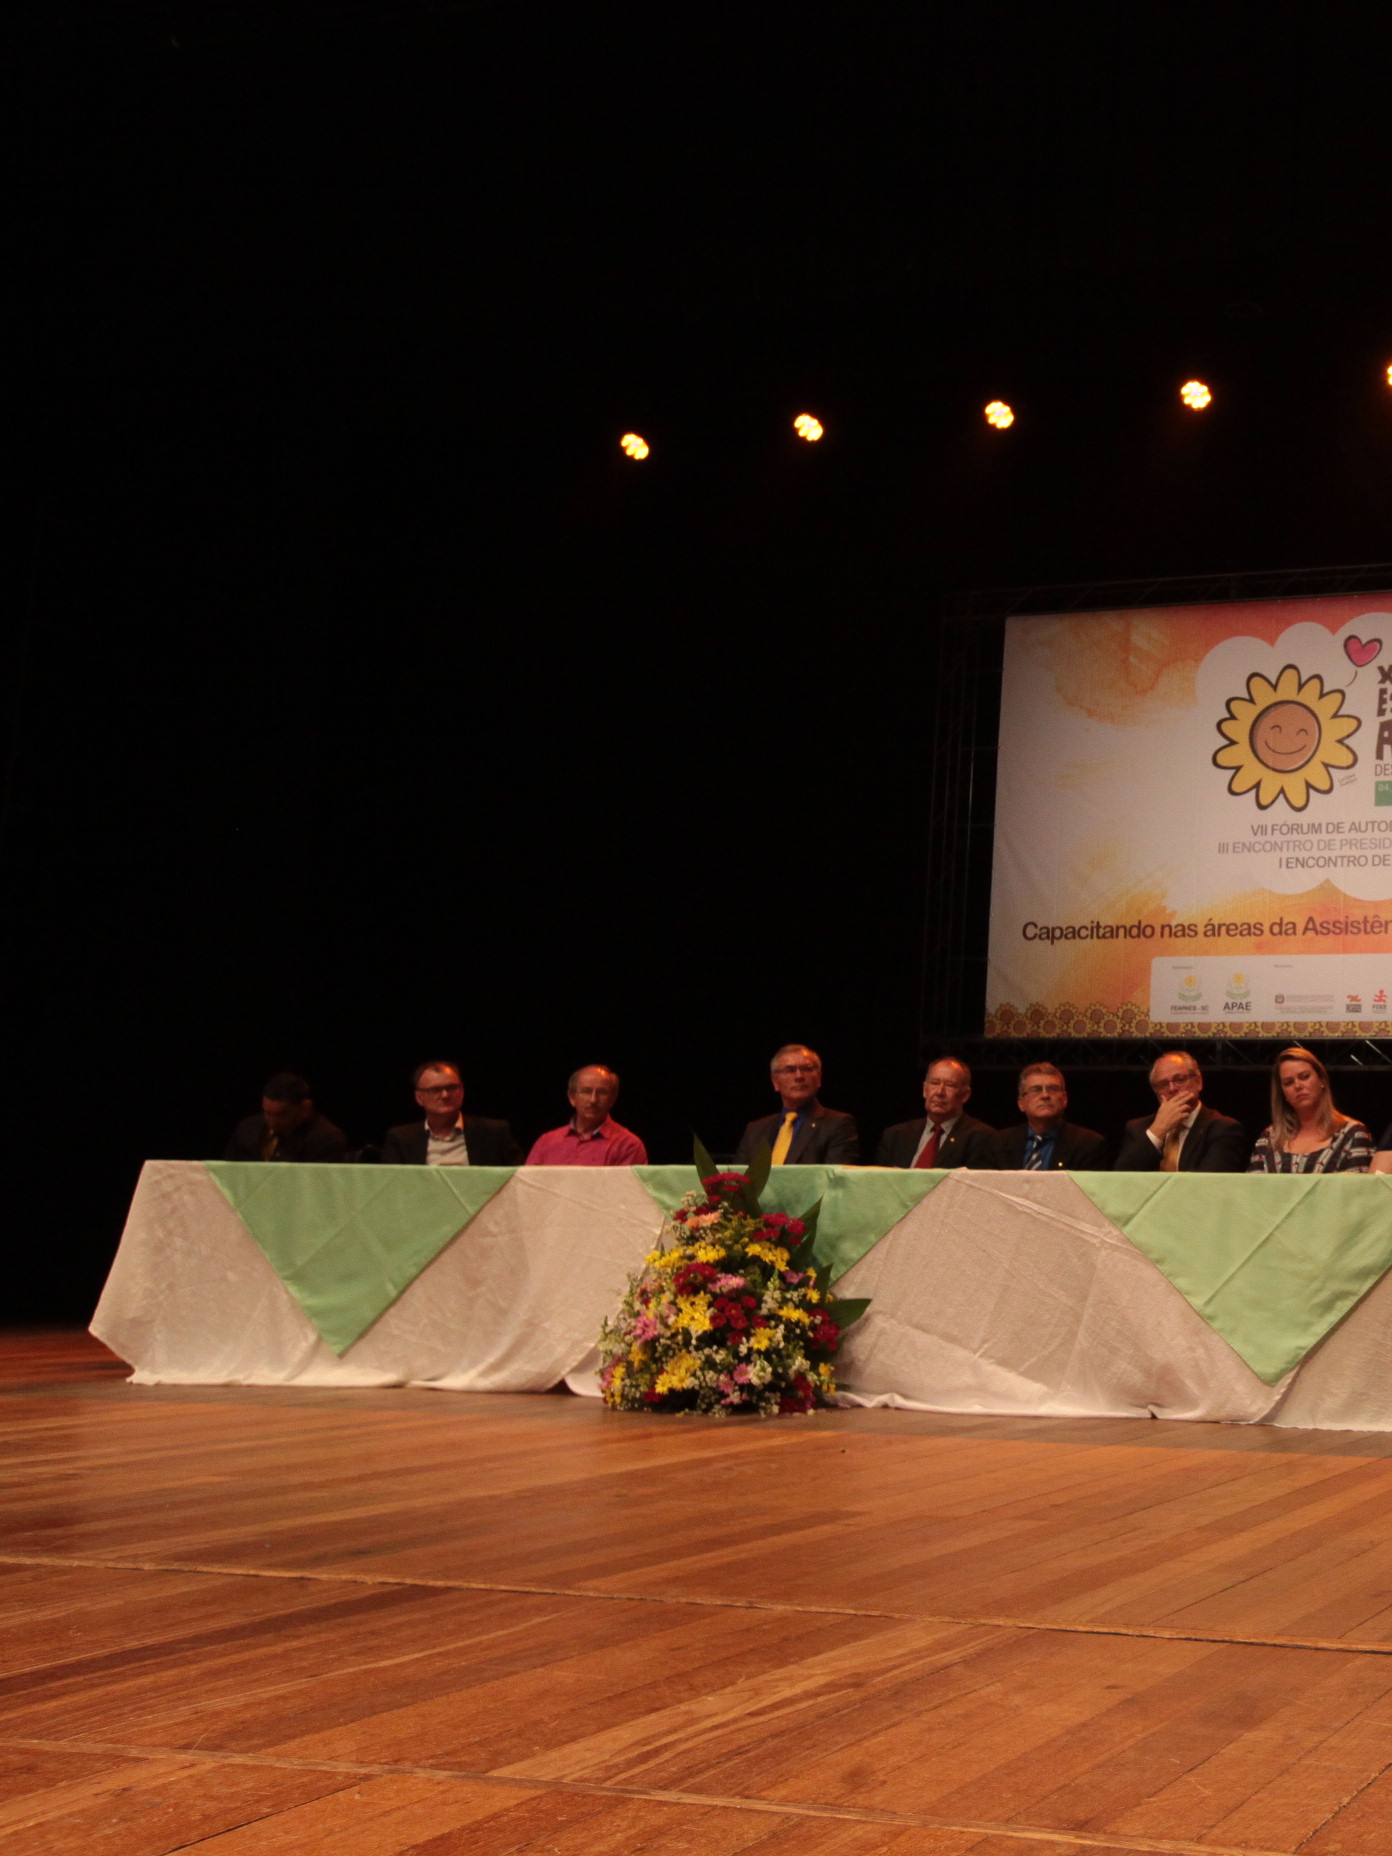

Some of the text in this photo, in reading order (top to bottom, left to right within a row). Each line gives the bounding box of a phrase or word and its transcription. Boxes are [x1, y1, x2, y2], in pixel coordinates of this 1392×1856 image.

[1250, 824, 1267, 837] VII
[1271, 821, 1322, 836] FÓRUM
[1325, 822, 1344, 834] DE
[1218, 842, 1229, 854] III
[1232, 839, 1314, 854] ENCONTRO
[1317, 838, 1336, 850] DE
[1279, 857, 1283, 869] I
[1285, 855, 1368, 869] ENCONTRO
[1371, 854, 1392, 867] DE
[1022, 920, 1156, 945] Capacitando
[1159, 923, 1199, 938] nas
[1202, 918, 1265, 938] áreas
[1268, 917, 1297, 936] da
[1223, 1001, 1252, 1011] APAE
